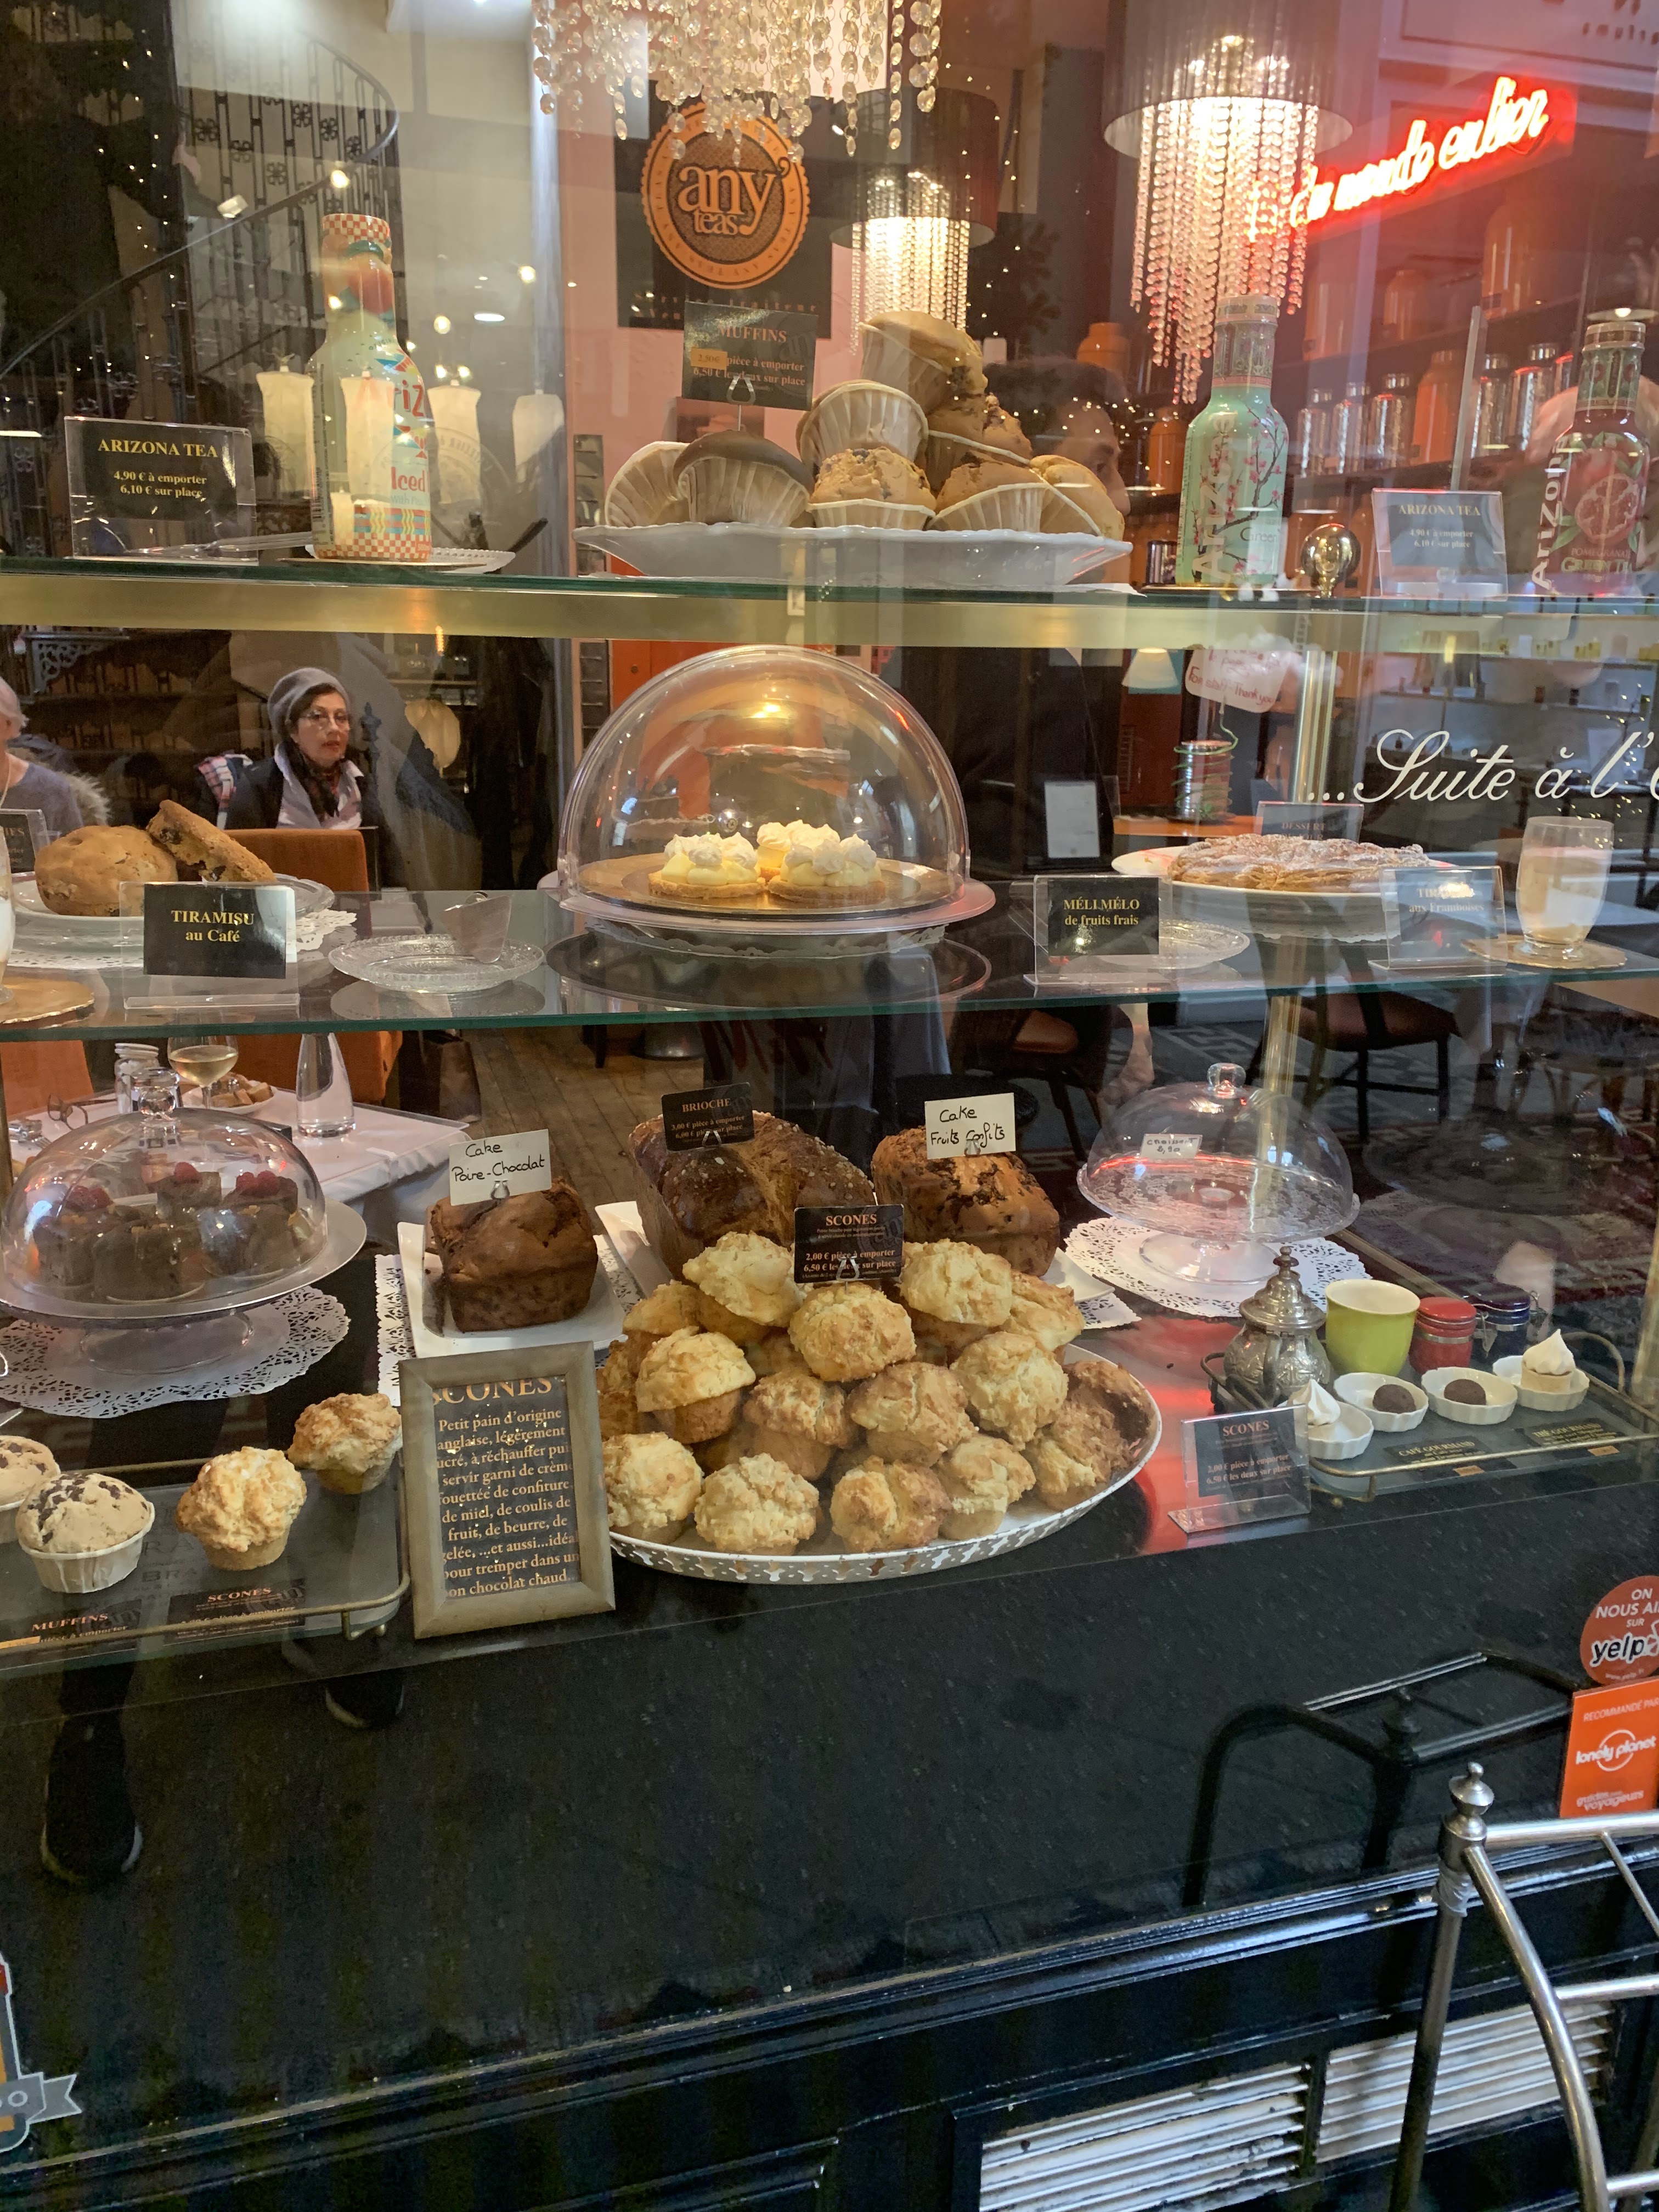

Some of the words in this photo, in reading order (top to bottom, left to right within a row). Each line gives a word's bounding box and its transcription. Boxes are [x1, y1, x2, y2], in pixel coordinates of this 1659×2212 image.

[694, 210, 738, 235] teas
[718, 323, 787, 343] MUFFINS
[761, 360, 805, 371] emporter
[781, 376, 805, 386] place
[98, 439, 180, 456] ARIZONA
[183, 443, 218, 458] TEA
[148, 472, 155, 481] à
[157, 475, 207, 486] emporter
[155, 488, 172, 496] sur
[174, 488, 203, 499] place
[1399, 504, 1454, 515] ARIZONA
[1456, 505, 1481, 516] TEA
[1101, 896, 1140, 910] MÉLO
[171, 910, 254, 926] TIRAMISU
[1064, 915, 1078, 926] de
[1081, 915, 1110, 926] fruits
[1114, 914, 1139, 926] frais
[185, 932, 203, 941] au
[207, 929, 240, 943] Café
[682, 1098, 731, 1113] BRIOCHE
[940, 1105, 978, 1122] Cake
[715, 1115, 745, 1125] emporter
[726, 1124, 743, 1133] place
[930, 1128, 960, 1146] Fruits
[966, 1122, 1005, 1148] Confits
[465, 1140, 503, 1158] Cake
[826, 1214, 877, 1226] SCONES
[805, 1252, 822, 1261] 2,00
[860, 1249, 896, 1259] emporter
[804, 1263, 820, 1272] 6,50
[822, 1263, 828, 1271] €
[876, 1260, 896, 1269] place
[432, 1377, 552, 1406] CONES
[439, 1418, 470, 1432] Petit
[472, 1414, 500, 1432] pain
[504, 1409, 562, 1425] d'origine
[1222, 1419, 1269, 1436] SCONES
[437, 1434, 493, 1453] anglaise,
[495, 1427, 566, 1447] légèrement
[437, 1454, 468, 1469] ucré,
[471, 1452, 478, 1464] à
[482, 1443, 545, 1463] réchauffer
[442, 1471, 479, 1486] servir
[482, 1466, 516, 1485] garni
[519, 1463, 534, 1476] de
[494, 1485, 509, 1498] de
[442, 1510, 458, 1523] de
[461, 1505, 494, 1521] miel,
[497, 1503, 512, 1516] de
[515, 1498, 553, 1513] coulis
[556, 1495, 571, 1509] de
[448, 1527, 482, 1542] fruit,
[486, 1523, 501, 1537] de
[504, 1521, 550, 1534] beurre,
[552, 1514, 568, 1528] de
[476, 1559, 528, 1576] tremper
[531, 1554, 561, 1568] dans
[208, 1587, 271, 1602] SCONES
[448, 1587, 466, 1598] on
[469, 1576, 525, 1595] chocolat
[1631, 1588, 1653, 1601] ON
[1595, 1602, 1640, 1619] NOUS
[1642, 1601, 1659, 1615] AI
[32, 1612, 108, 1632] MUFFINS
[1626, 1618, 1645, 1628] SUR
[1592, 1634, 1645, 1664] yelp
[1575, 1744, 1614, 1765] lonely
[1616, 1735, 1657, 1759] planet
